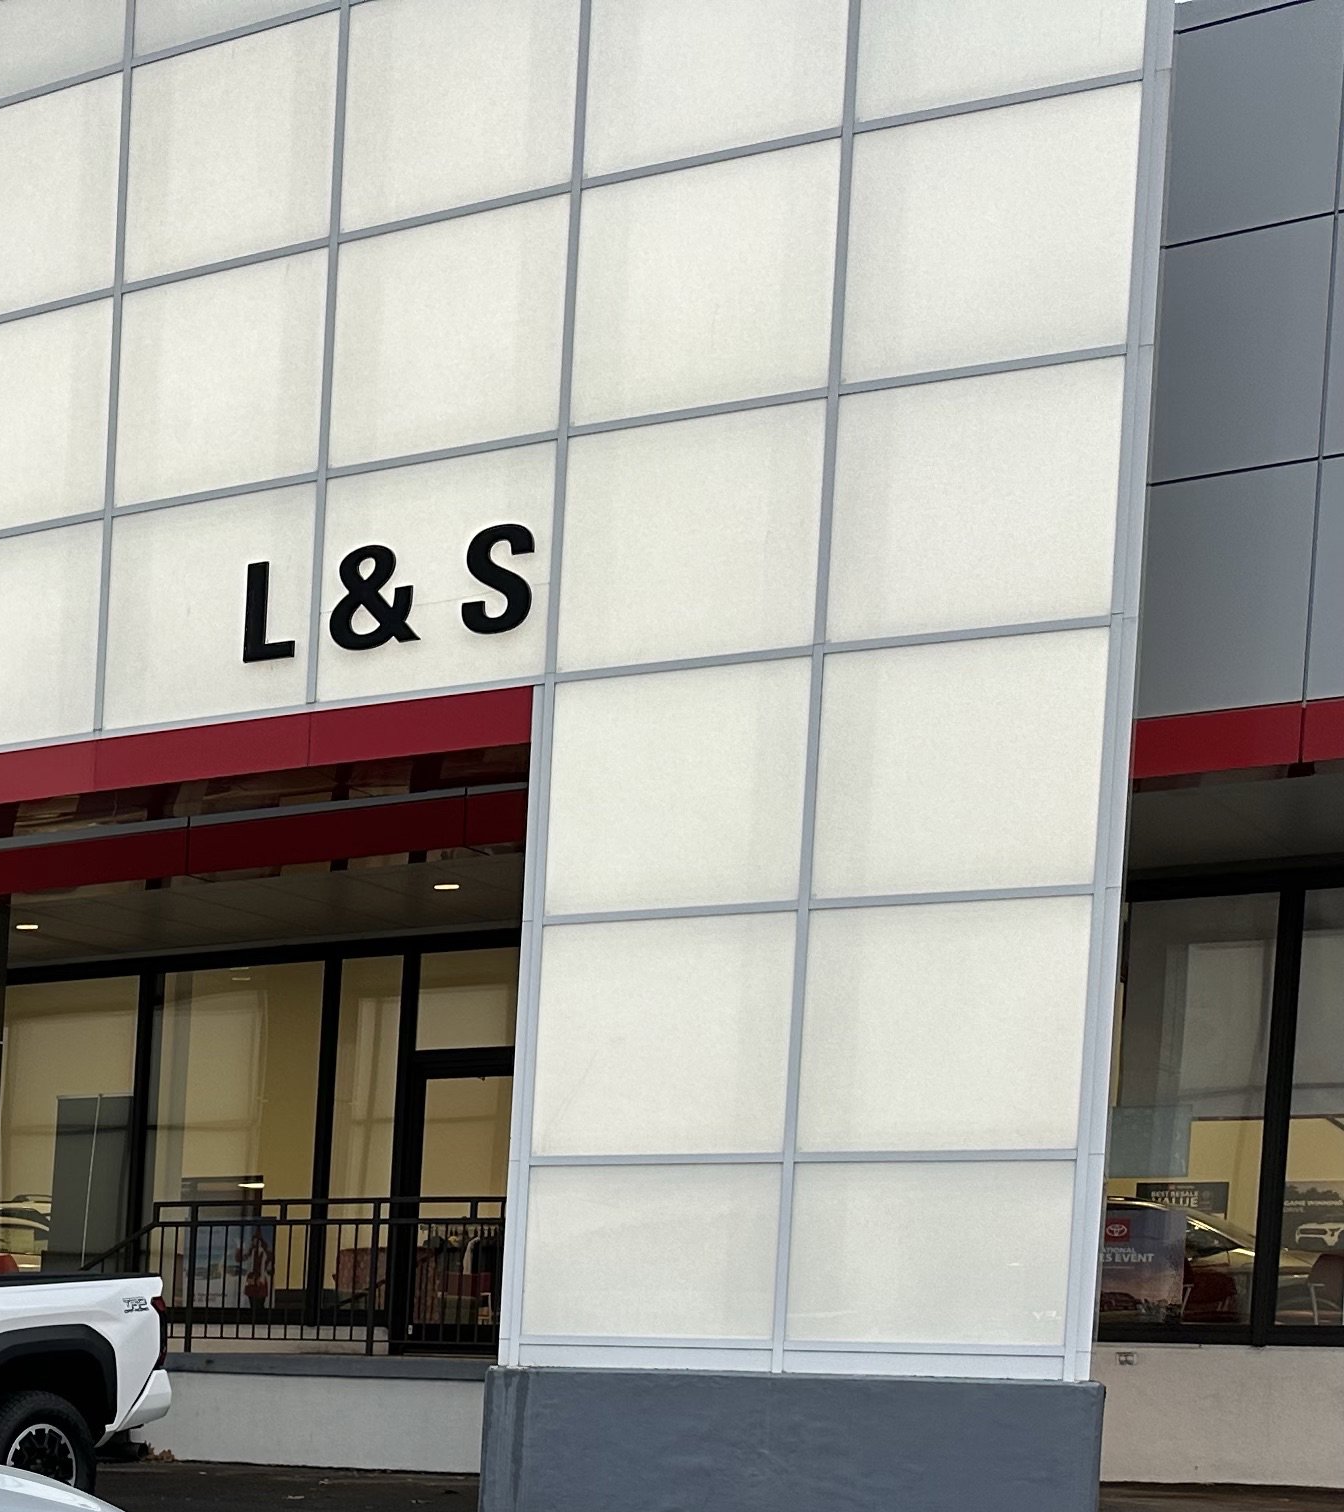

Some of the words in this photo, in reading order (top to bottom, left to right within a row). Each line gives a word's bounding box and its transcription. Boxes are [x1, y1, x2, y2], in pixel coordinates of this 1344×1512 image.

[242, 561, 296, 664] L
[329, 544, 421, 651] &
[461, 523, 535, 635] S
[1114, 1253, 1154, 1263] EVENT
